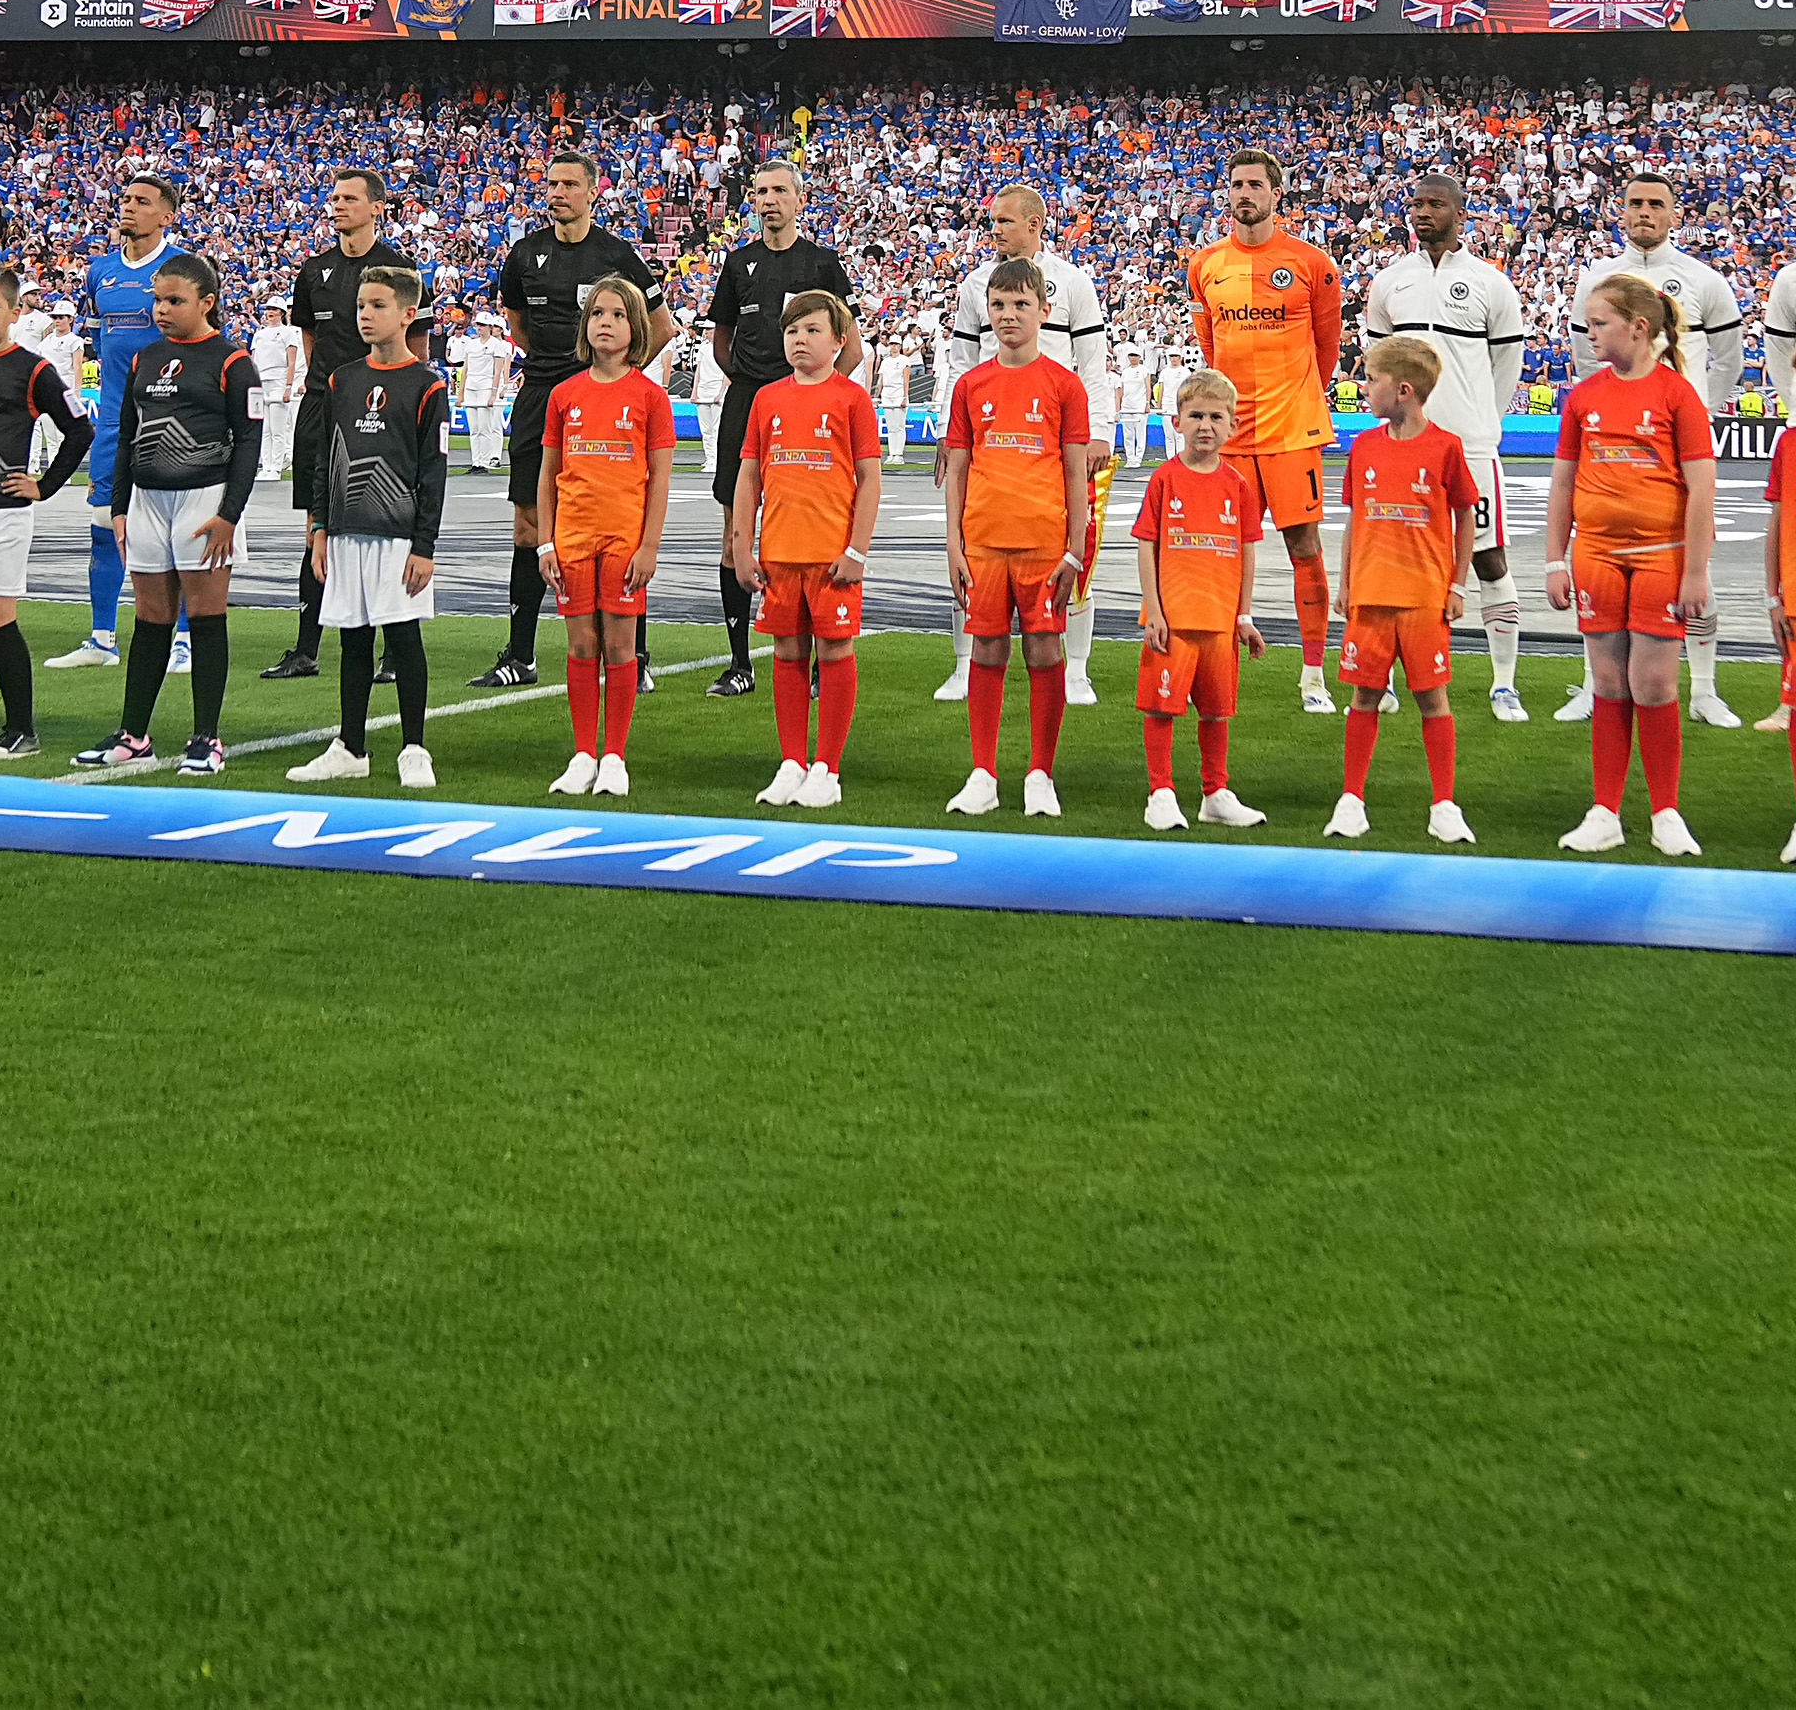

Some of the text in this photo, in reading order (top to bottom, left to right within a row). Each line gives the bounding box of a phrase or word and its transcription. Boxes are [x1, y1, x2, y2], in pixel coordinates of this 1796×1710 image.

[820, 0, 826, 8] &
[75, 18, 133, 28] Foundation
[1002, 25, 1030, 35] EAST
[1038, 26, 1087, 36] GERMAN
[1218, 303, 1286, 321] indeed
[1239, 322, 1286, 331] Jobs finden
[146, 384, 178, 393] EUROPA
[355, 419, 386, 430] EUROPA
[1306, 468, 1318, 501] 1
[148, 812, 958, 877] МИР
